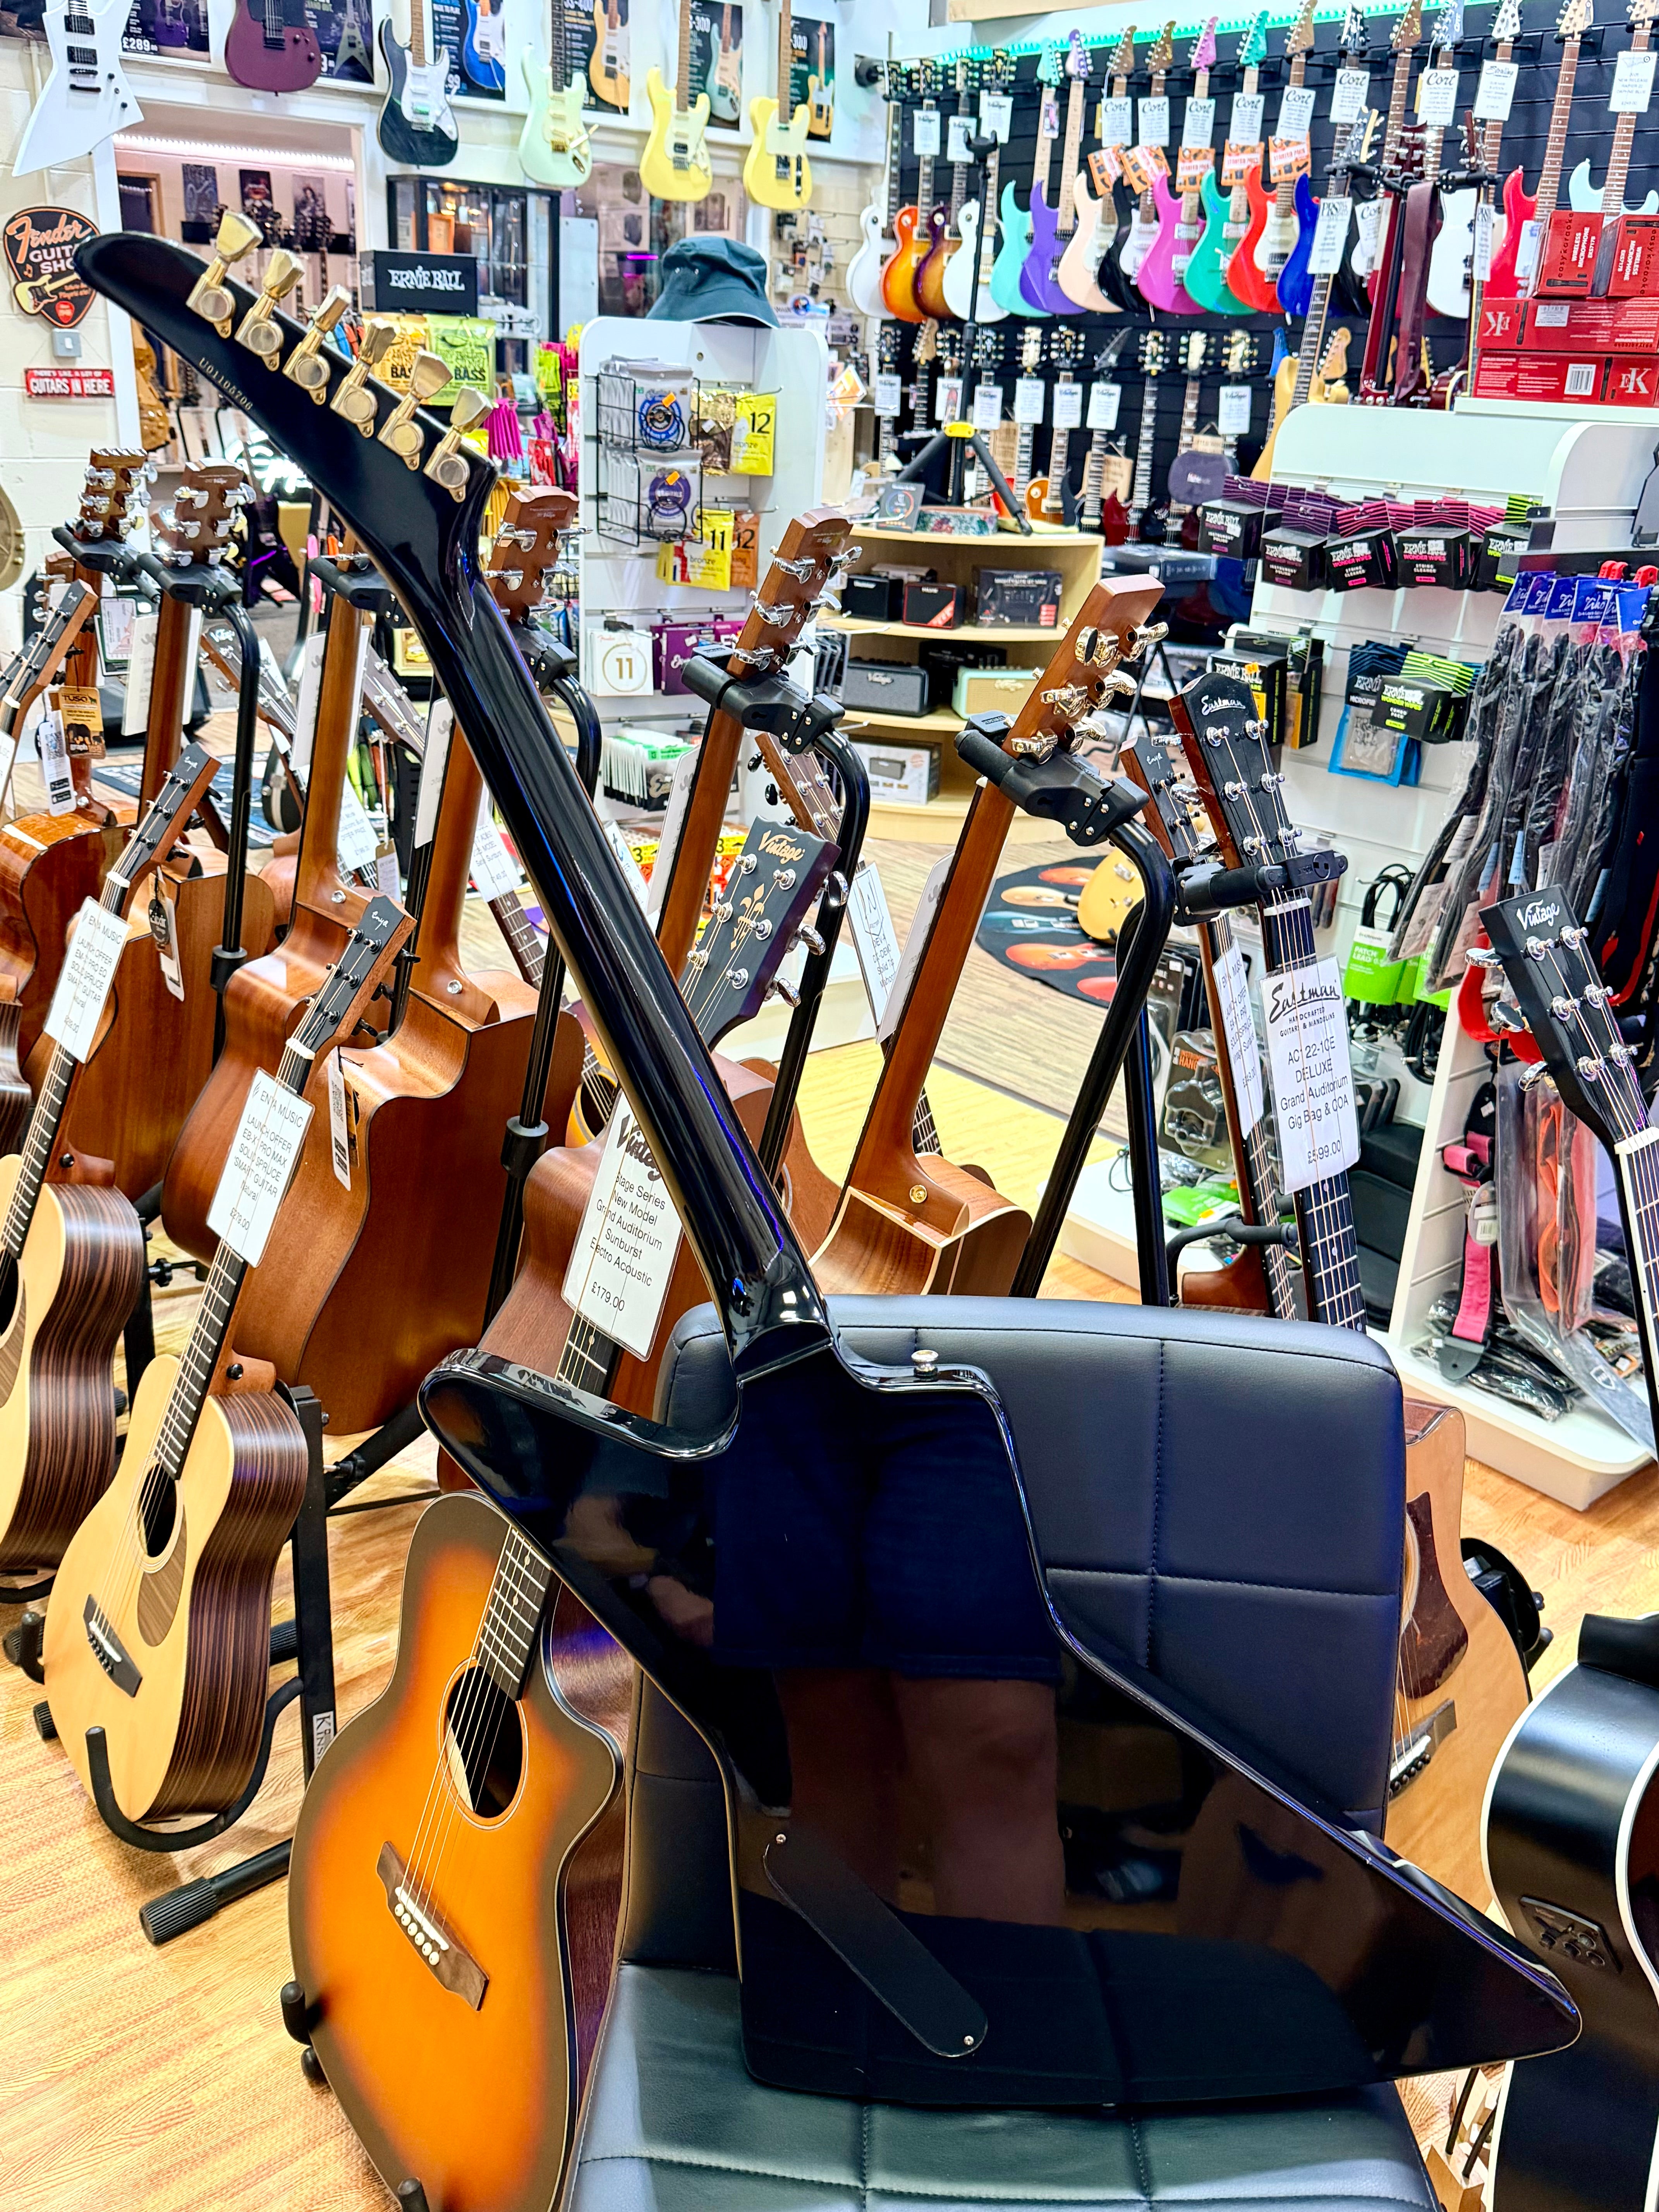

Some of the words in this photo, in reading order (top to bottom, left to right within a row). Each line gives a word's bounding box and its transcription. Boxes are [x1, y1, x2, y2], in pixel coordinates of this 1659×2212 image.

[1339, 72, 1367, 86] Cort
[1427, 72, 1455, 86] Cort
[1105, 101, 1128, 113] Cort
[1143, 101, 1166, 113] Cort
[1189, 101, 1212, 114] Cort
[1236, 96, 1260, 110] Cort
[1286, 90, 1311, 105] Cort
[6, 213, 92, 264] Fender
[1571, 232, 1581, 262] WIRELESS
[1577, 227, 1590, 268] MICROPHONE
[29, 244, 80, 263] GUIT
[1623, 240, 1636, 281] MICROPHONE
[1632, 246, 1642, 275] WIRELESS
[40, 258, 75, 274] SHO
[388, 265, 431, 290] ERNIE
[431, 269, 465, 291] BALL
[391, 365, 412, 378] BA
[454, 368, 486, 381] BASS
[30, 378, 70, 394] GUITARS
[82, 379, 112, 395] HERE
[750, 412, 771, 434] 12
[1206, 511, 1225, 525] ERNIE
[710, 529, 725, 551] 11
[736, 529, 755, 549] 12
[1403, 540, 1426, 555] ERNIE
[689, 555, 716, 565] bronze
[1265, 544, 1284, 558] ERNI
[1330, 545, 1352, 562] ERNIE
[1332, 558, 1355, 568] WONDER
[1355, 554, 1372, 562] WIPES
[1487, 548, 1502, 557] WON
[616, 658, 633, 680] 11
[1214, 662, 1241, 680] ERNIE
[1354, 675, 1382, 692] ERNI
[1384, 684, 1405, 699] ERNIE
[1201, 695, 1246, 716] Eastman
[1381, 694, 1404, 706] WONDER
[1404, 701, 1423, 711] WIPES
[632, 847, 643, 863] 3
[758, 830, 805, 864] Vintage
[1516, 899, 1560, 931] Vintage
[101, 926, 122, 945] MUSIC
[95, 949, 113, 966] OFFER
[1353, 952, 1371, 963] LEAD
[1354, 946, 1377, 958] PATCH
[82, 985, 101, 1004] GUITAR
[1269, 982, 1340, 1024] Eastman
[1309, 1012, 1335, 1027] MANDOLINS
[1288, 1036, 1336, 1065] AC22-1CE
[1179, 1056, 1197, 1071] HANG
[1295, 1058, 1333, 1083] DELUXE
[1280, 1089, 1305, 1111] Grand
[1309, 1075, 1348, 1099] Auditorium
[260, 1090, 277, 1111] ENYA
[278, 1104, 303, 1128] MUSIC
[1288, 1115, 1302, 1130] Gig
[1304, 1108, 1322, 1124] Bag
[1324, 1102, 1331, 1116] &
[1332, 1094, 1349, 1112] COA
[247, 1113, 268, 1139] LAUNCH
[270, 1131, 292, 1154] OFFER
[242, 1127, 260, 1146] EB-X
[260, 1141, 272, 1157] PRO
[271, 1151, 288, 1169] MAX
[617, 1114, 661, 1181] Vintag
[239, 1143, 256, 1163] SOLID
[257, 1156, 282, 1183] SPRUCE
[240, 1179, 259, 1201] Natural
[254, 1174, 278, 1198] GUITAR
[615, 1171, 634, 1192] Stage
[636, 1185, 666, 1210] Series
[612, 1189, 628, 1209] New
[629, 1202, 658, 1226] Model
[616, 1215, 662, 1250] Auditorium
[605, 1228, 643, 1260] Sunburst
[590, 1237, 613, 1263] Eectro
[613, 1256, 653, 1286] Acoustic
[591, 1281, 625, 1311] £179.00
[316, 1716, 331, 1761] KINS
